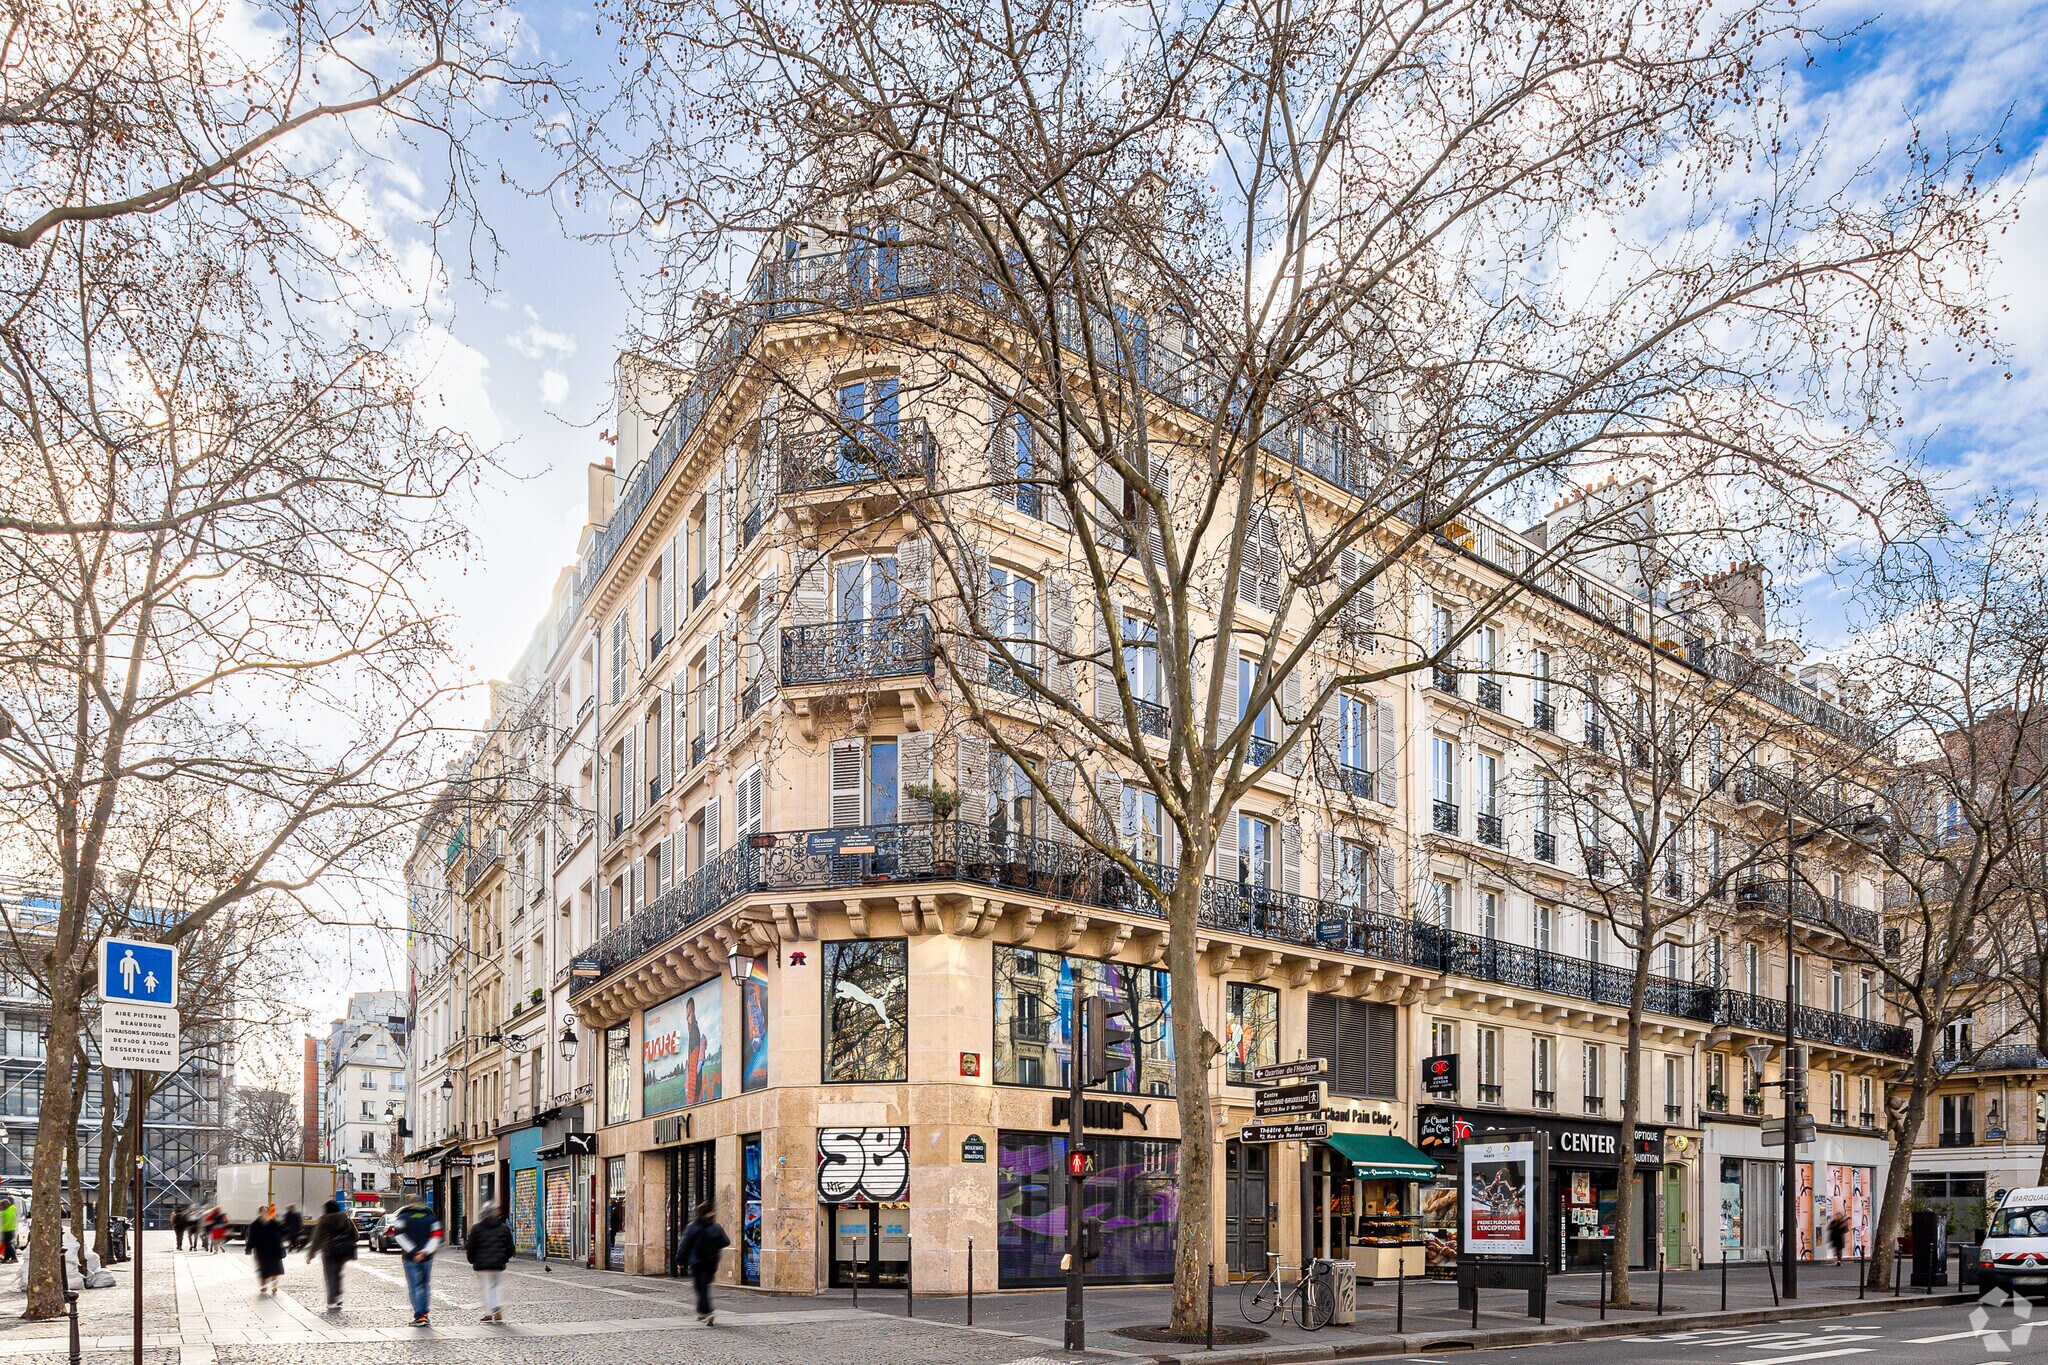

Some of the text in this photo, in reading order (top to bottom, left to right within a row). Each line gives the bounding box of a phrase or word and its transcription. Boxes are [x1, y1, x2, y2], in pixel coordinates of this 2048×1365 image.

[134, 1012, 167, 1020] PIÉTONNE
[120, 1020, 162, 1028] BEAUBOURG
[644, 1030, 679, 1062] FUTURE
[1264, 1064, 1316, 1076] Quartier de l'Horloge
[1052, 1097, 1123, 1129] PMA
[1325, 1107, 1350, 1122] Chaud
[1352, 1110, 1370, 1123] Pain
[1372, 1110, 1392, 1125] Choc
[653, 1115, 681, 1144] PUMA
[1436, 1124, 1450, 1134] Choc
[1634, 1130, 1658, 1141] OPTIQUE
[1561, 1132, 1616, 1154] CENTER
[1644, 1142, 1649, 1151] &
